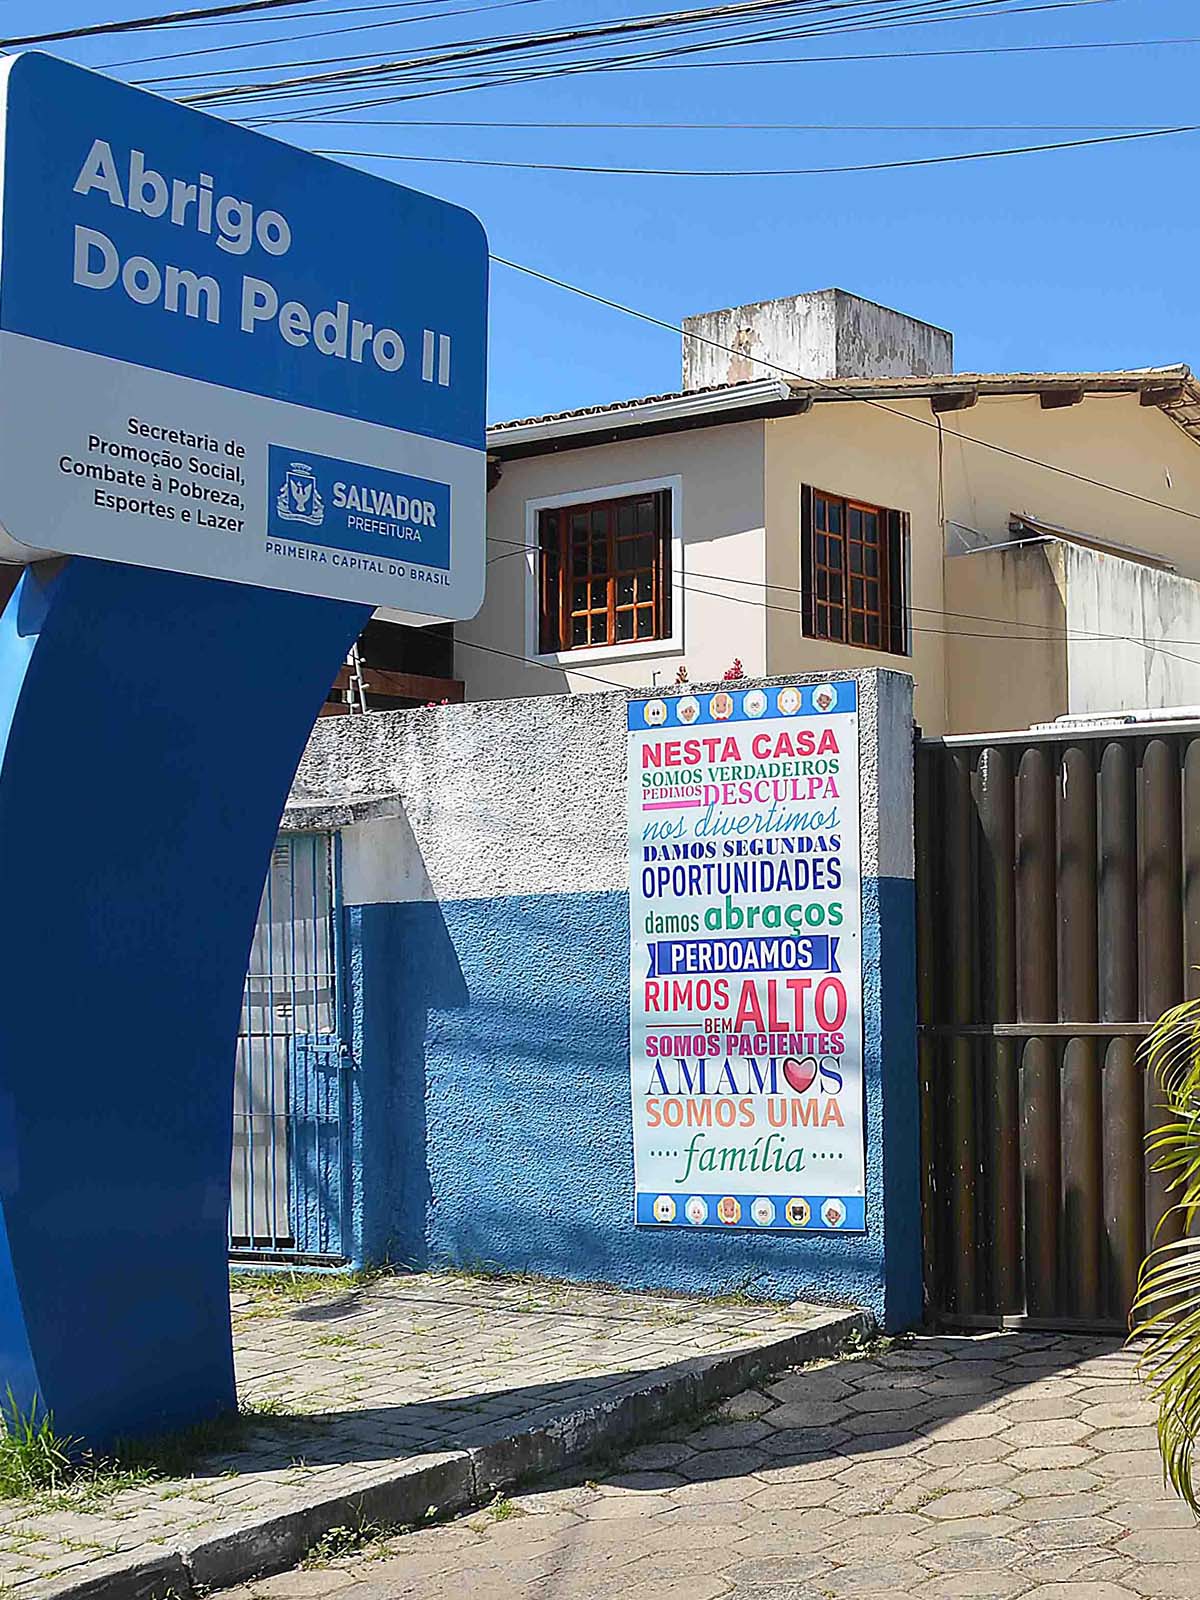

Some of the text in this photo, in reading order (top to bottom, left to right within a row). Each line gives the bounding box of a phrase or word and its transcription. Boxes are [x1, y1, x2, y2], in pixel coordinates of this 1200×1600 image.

[73, 138, 292, 256] Abrigo
[73, 225, 451, 387] Dom Pedro II
[128, 418, 246, 459] Secretaria de
[88, 435, 246, 487] Promoção Social,
[59, 456, 245, 511] Combate à Pobreza,
[94, 489, 245, 533] Esportes e Lazer
[332, 481, 437, 528] SALVADOR
[347, 515, 422, 543] PREFEITURA
[265, 541, 451, 587] PRIMEIRA CAPITAL DO BRASIL
[642, 729, 840, 768] NESTA CASA
[641, 758, 840, 787] SOMOS VERDADEIROS
[642, 776, 840, 807] PEDIMOS DESCULPA
[642, 800, 841, 841] nos divertimos
[643, 834, 841, 862] DAMOS SEGUNDAS
[642, 857, 842, 898] OPORTUNIDADES
[644, 895, 844, 937] damos abraços
[671, 939, 813, 972] PERDOAMOS
[644, 976, 848, 1033] RIMOS ALTO
[645, 1033, 845, 1057] SOMOS PACIENTES
[704, 1017, 732, 1034] BEM
[646, 1098, 845, 1128] SOMOS UMA
